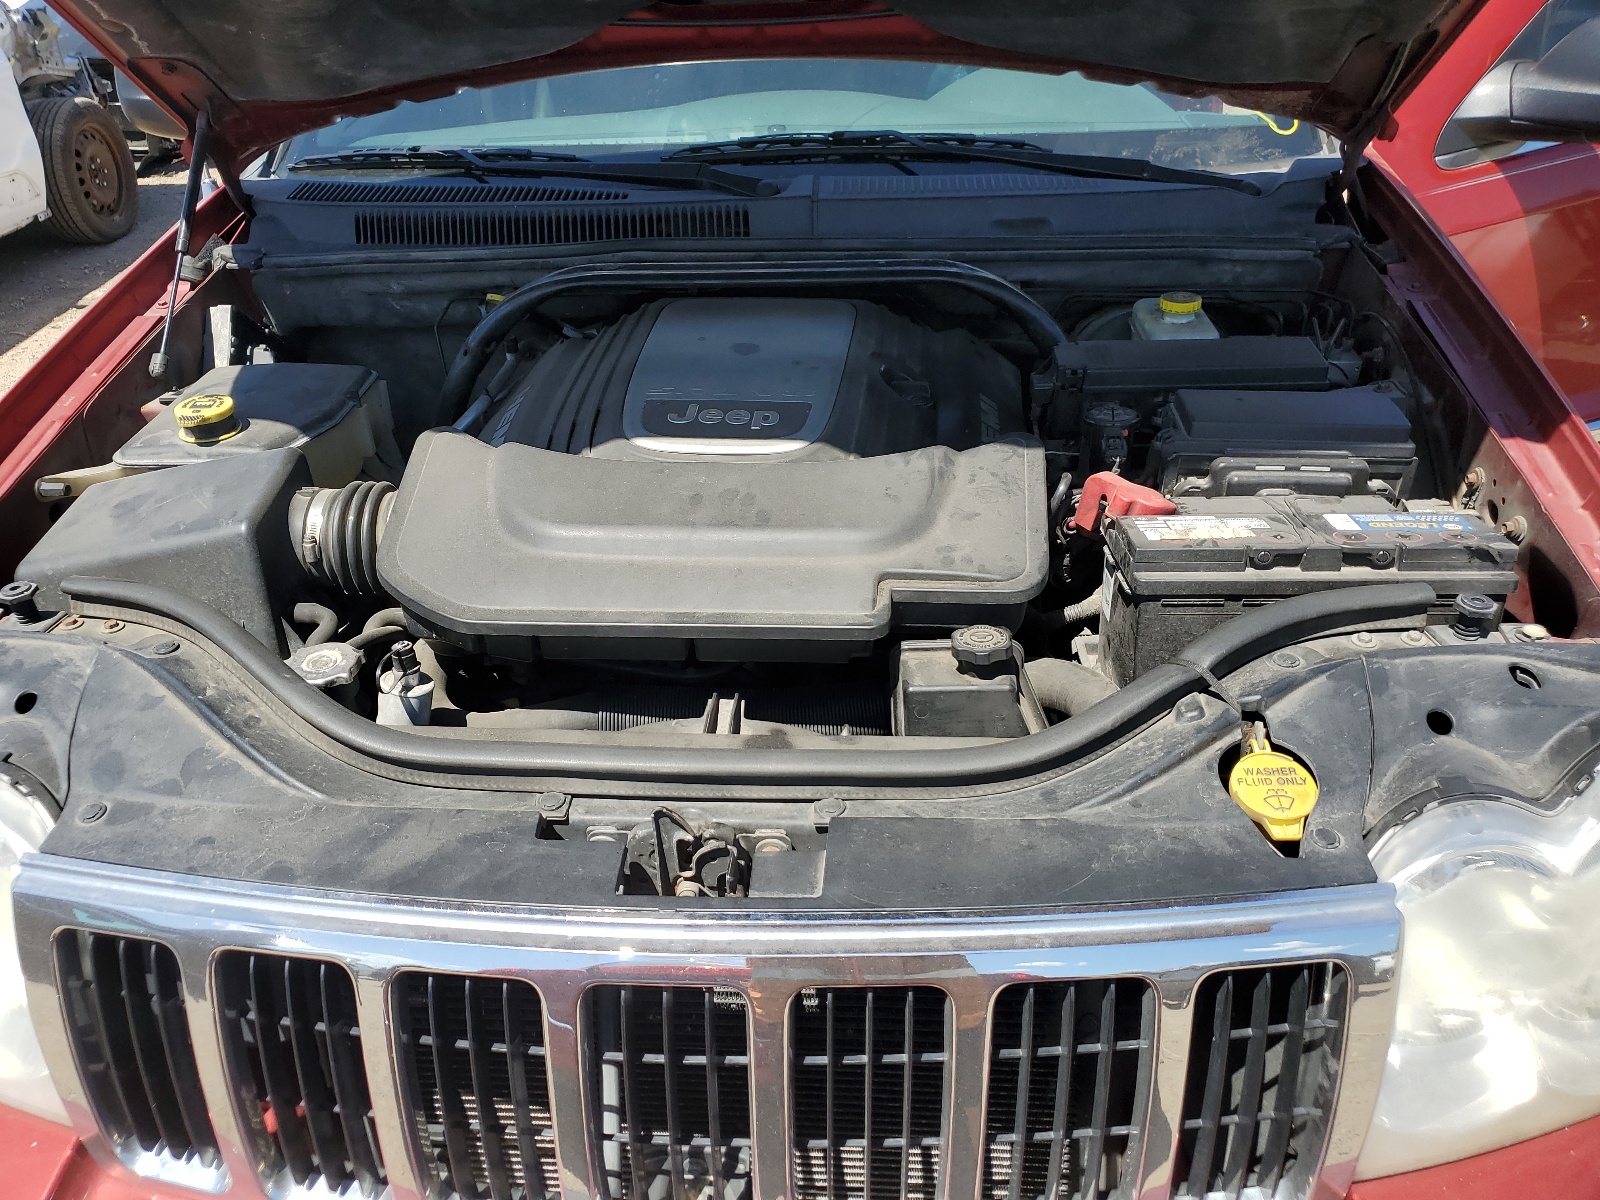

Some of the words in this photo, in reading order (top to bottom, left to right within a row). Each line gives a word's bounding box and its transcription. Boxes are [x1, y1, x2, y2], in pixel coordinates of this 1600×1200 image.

[667, 404, 780, 430] Jeep
[1243, 766, 1297, 776] WASHER
[1237, 777, 1273, 787] FLUID
[1276, 776, 1307, 786] ONLY
